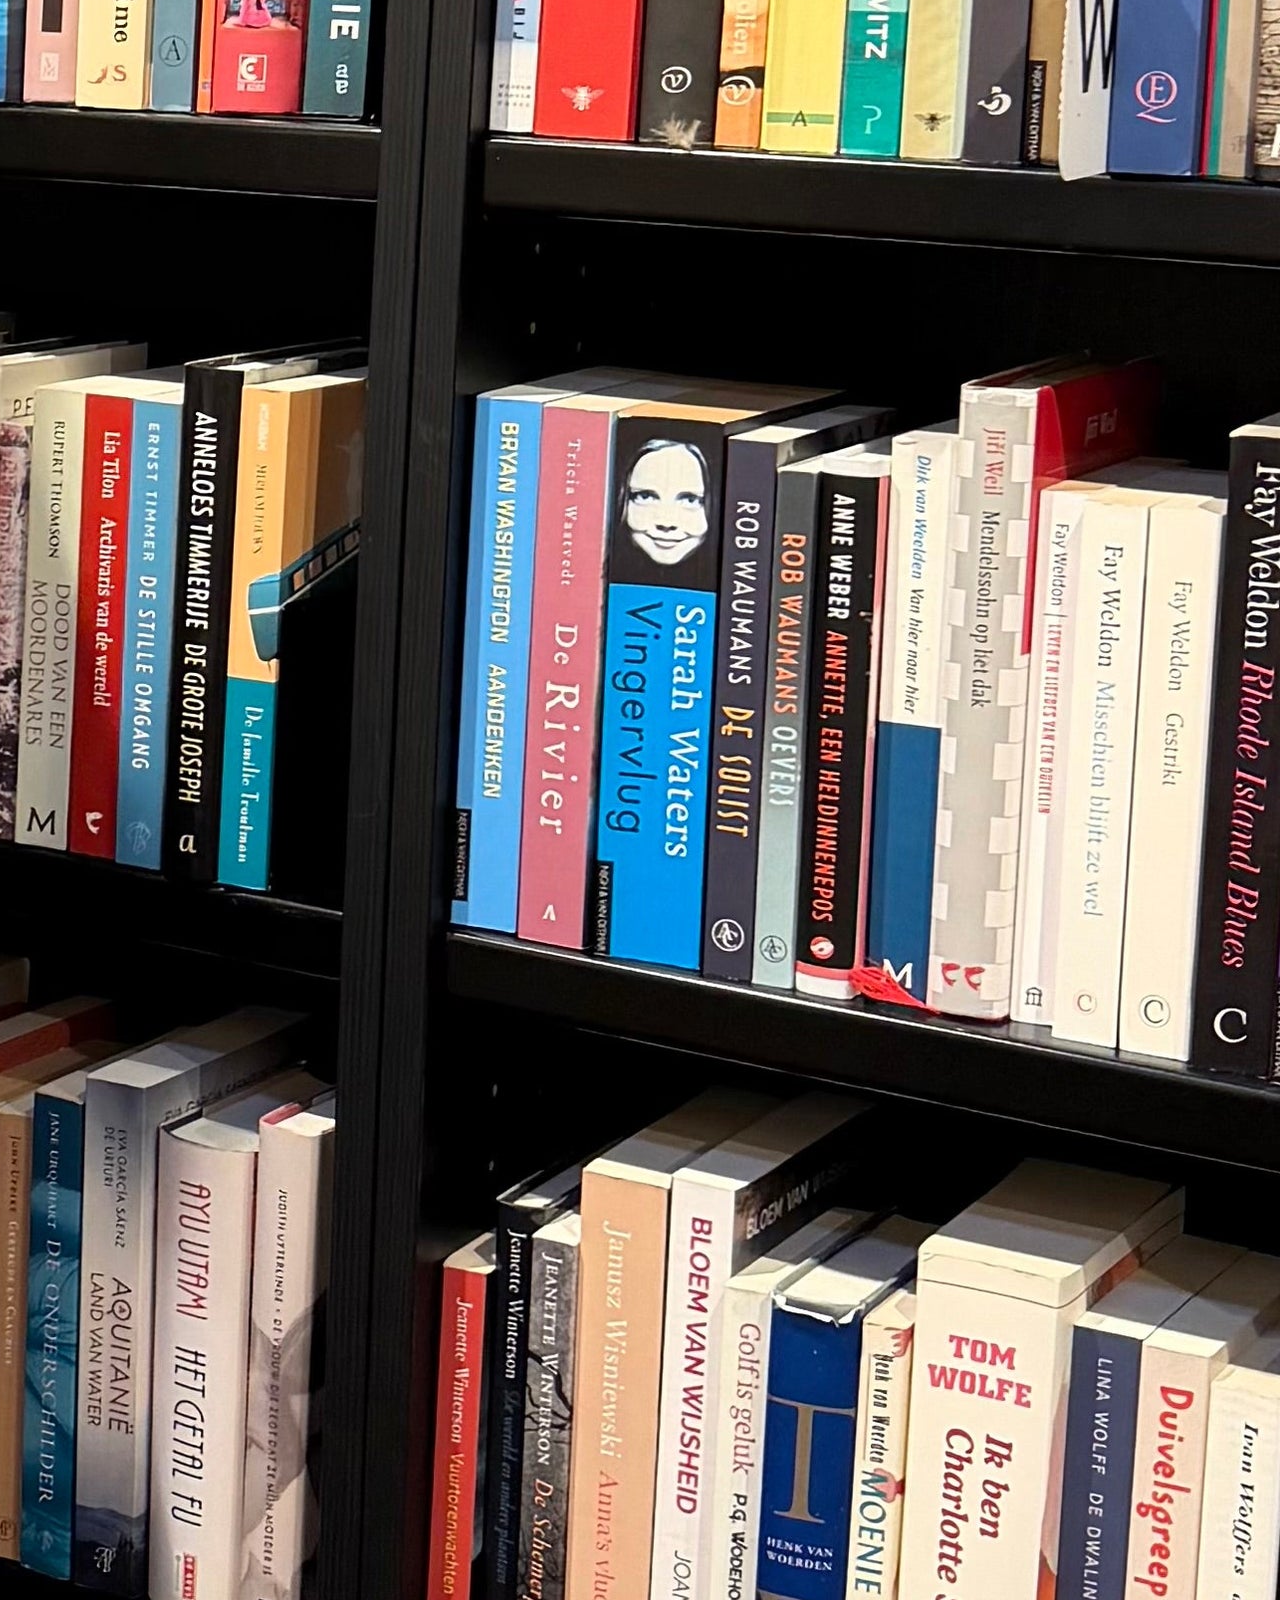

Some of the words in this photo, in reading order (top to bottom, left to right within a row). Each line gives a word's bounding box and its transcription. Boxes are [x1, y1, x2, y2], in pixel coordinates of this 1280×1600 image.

[190, 411, 218, 520] ANNELOES
[498, 421, 520, 493] BRYAN
[185, 524, 214, 630] TIMMERIJE
[489, 499, 517, 644] WASHINGTON
[184, 642, 207, 672] DE
[669, 604, 708, 712] Sarah
[180, 676, 205, 734] GROTE
[482, 663, 506, 799] AANDENKEN
[606, 599, 664, 835] Vingervlug
[1240, 659, 1275, 764] Rhode
[178, 738, 202, 804] JOSEPH
[663, 727, 701, 858] Waters
[1231, 770, 1270, 873] Island
[1220, 882, 1260, 969] Blues
[178, 1179, 214, 1236] AYU
[176, 1238, 210, 1321] UTAMI
[688, 1217, 714, 1312] BLOEM
[174, 1345, 208, 1398] HET
[683, 1318, 709, 1375] VAN
[927, 1362, 1033, 1408] WOLFE
[948, 1333, 1017, 1369] TOM
[171, 1398, 208, 1482] GETAL
[676, 1381, 705, 1514] WIJSHEID
[982, 1434, 1014, 1464] Ik
[169, 1491, 205, 1529] FU
[939, 1427, 974, 1584] Charlotte
[977, 1472, 1009, 1541] ben
